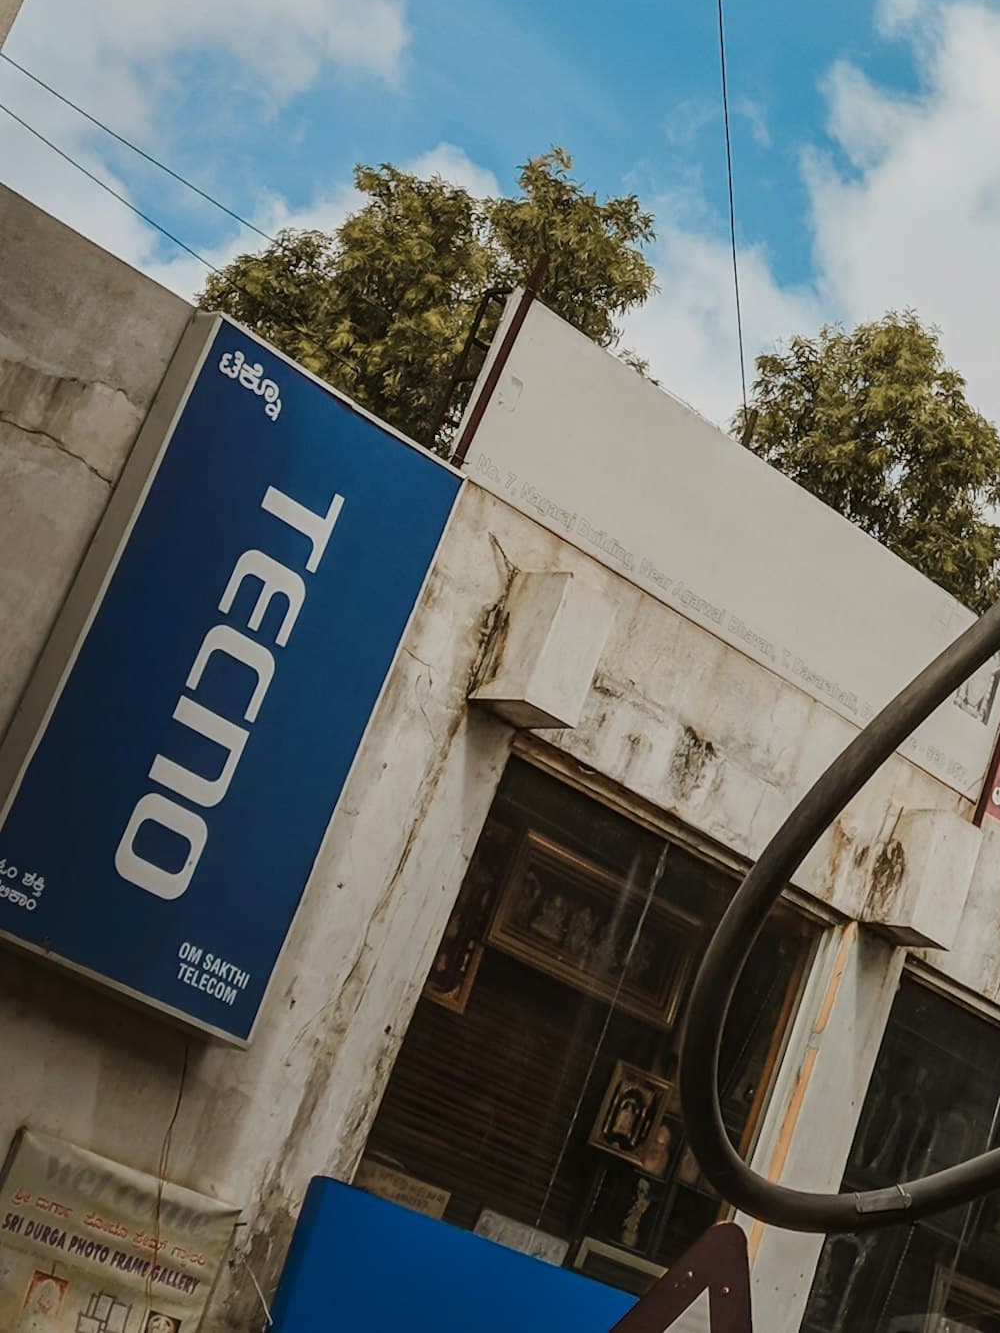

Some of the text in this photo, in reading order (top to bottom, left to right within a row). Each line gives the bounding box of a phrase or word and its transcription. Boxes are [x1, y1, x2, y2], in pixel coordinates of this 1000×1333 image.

[177, 963, 238, 1006] TELECOM
[178, 942, 251, 990] OM SAKTHI
[2, 1212, 24, 1233] SRI
[24, 1220, 68, 1248] DURGA
[68, 1235, 111, 1264] PHOTO
[110, 1250, 151, 1279] FRAME
[151, 1263, 202, 1297] GALLERY
